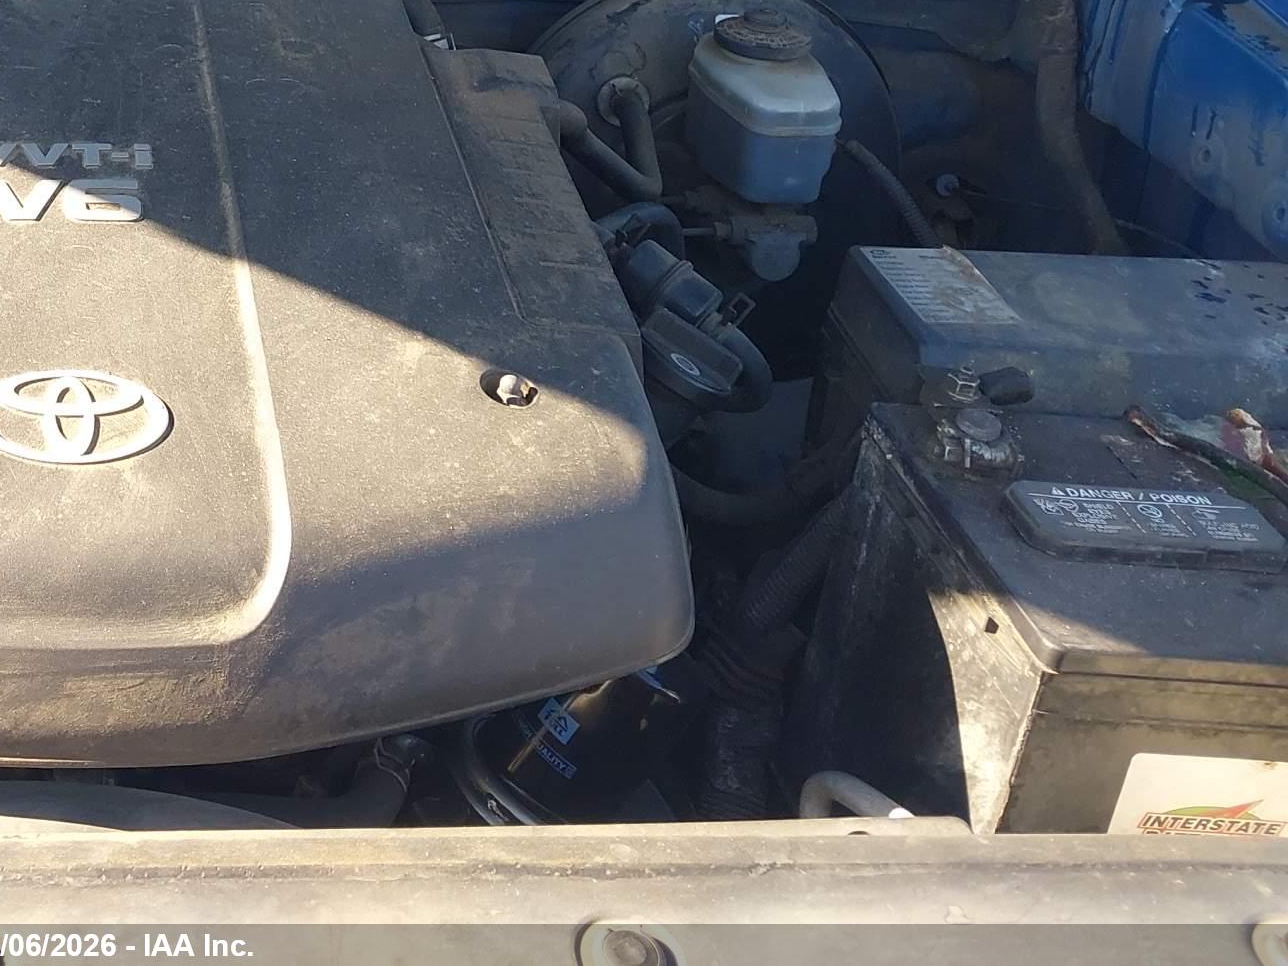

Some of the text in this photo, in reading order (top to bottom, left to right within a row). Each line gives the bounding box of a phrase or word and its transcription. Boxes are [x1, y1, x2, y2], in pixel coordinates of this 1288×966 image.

[1065, 487, 1135, 501] DANGER
[1149, 492, 1213, 505] POISON
[1141, 815, 1282, 836] INTERSTATE
